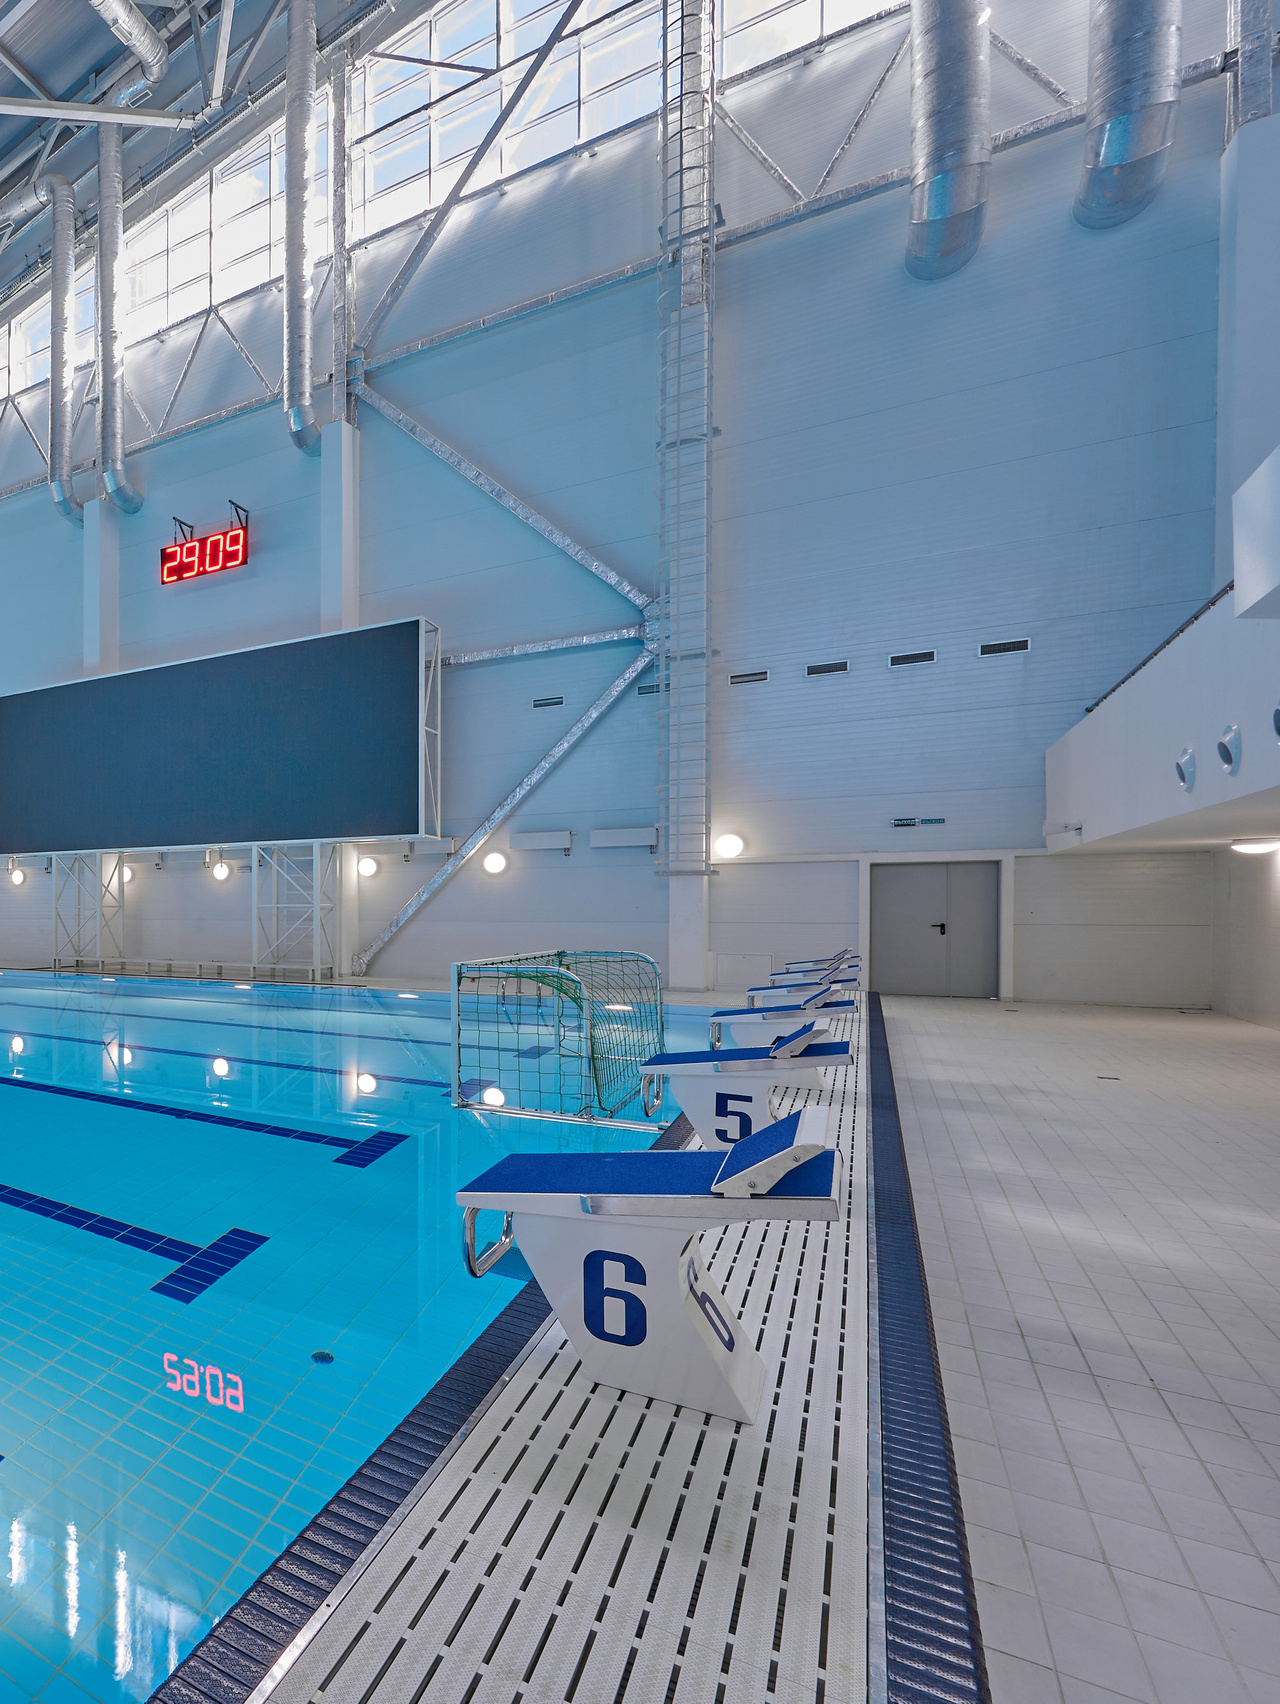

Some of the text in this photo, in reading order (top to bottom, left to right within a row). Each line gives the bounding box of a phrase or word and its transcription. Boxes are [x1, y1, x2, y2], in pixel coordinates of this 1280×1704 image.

[162, 528, 245, 583] 29.09
[714, 1091, 754, 1144] 5
[582, 1249, 648, 1347] 6
[686, 1255, 736, 1353] 6
